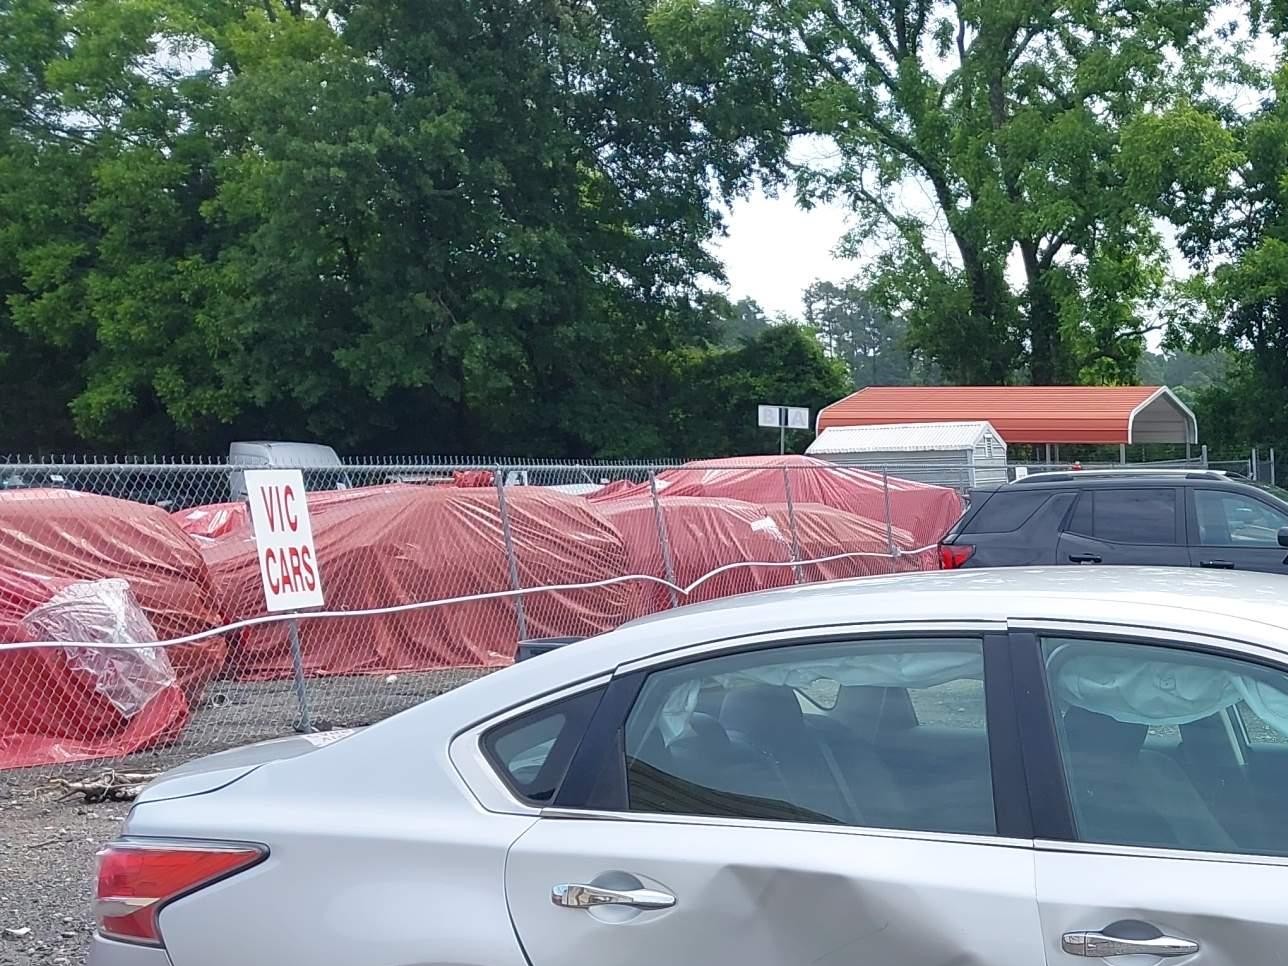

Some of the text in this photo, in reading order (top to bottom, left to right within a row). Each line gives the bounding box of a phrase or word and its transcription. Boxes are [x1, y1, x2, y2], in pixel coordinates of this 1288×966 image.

[763, 407, 775, 424] B
[791, 410, 807, 426] A
[260, 484, 298, 532] VIC
[265, 545, 316, 595] CARS
